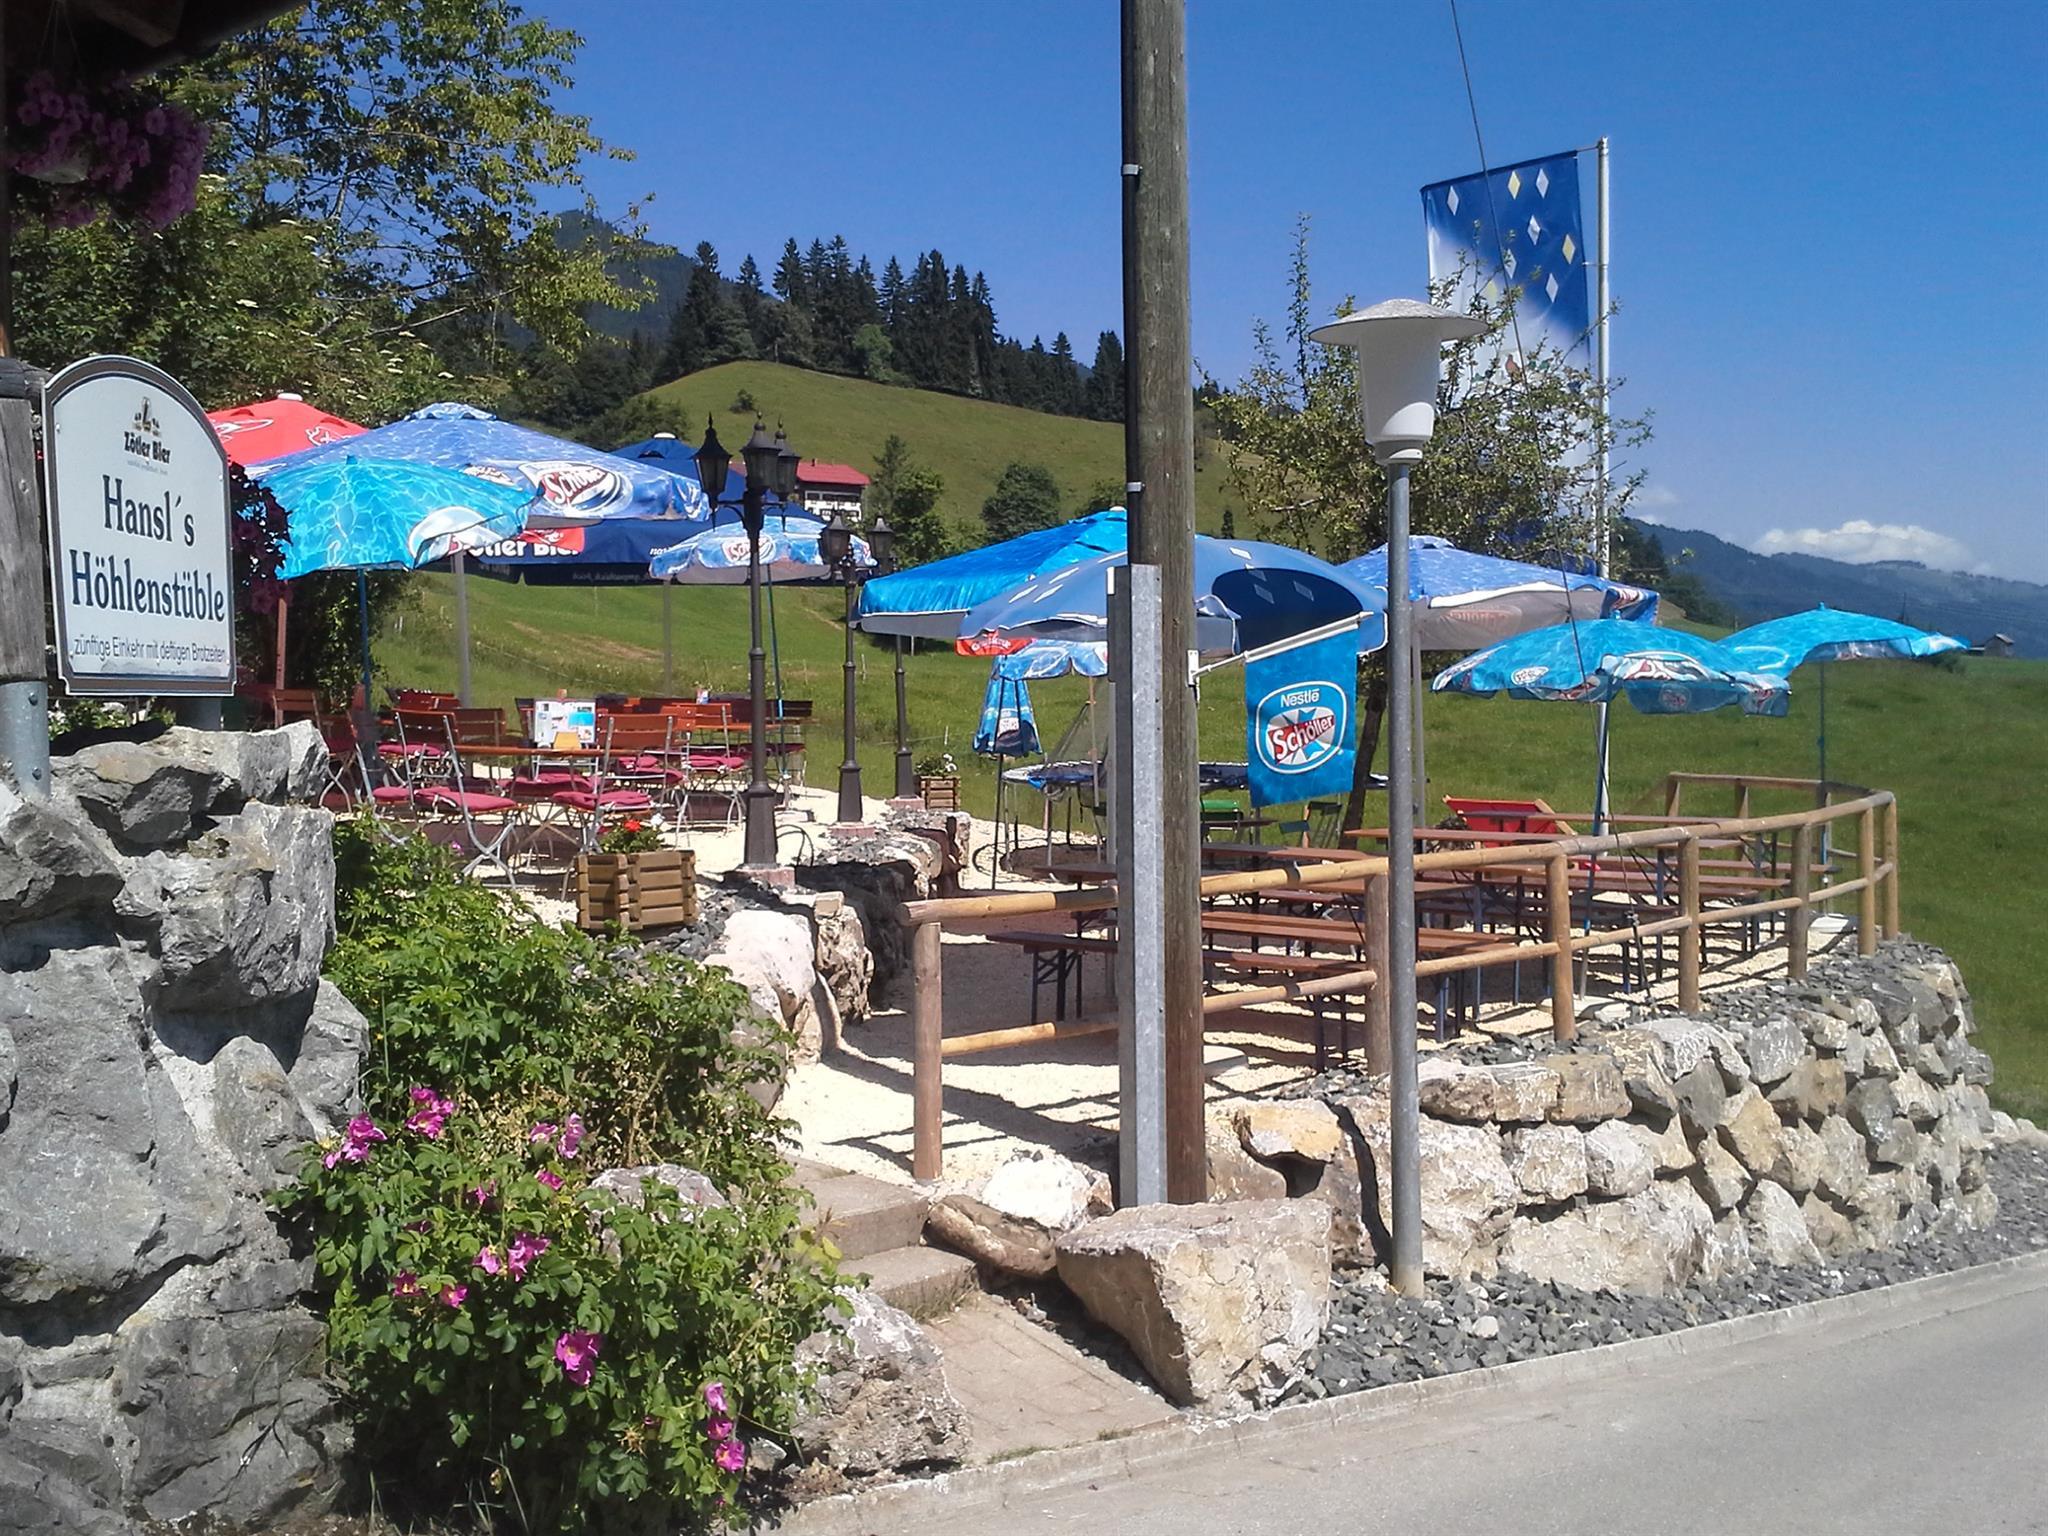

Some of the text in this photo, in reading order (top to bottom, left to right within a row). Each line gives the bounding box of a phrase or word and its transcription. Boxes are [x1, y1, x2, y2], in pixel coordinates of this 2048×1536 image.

[69, 548, 225, 622] Höhlenstüble
[74, 634, 111, 661] zünftige
[112, 636, 145, 659] Einkehr
[145, 640, 159, 660] mit
[160, 641, 190, 665] deftigen
[1280, 688, 1320, 708] Nestlé
[1272, 714, 1334, 760] Schöller
